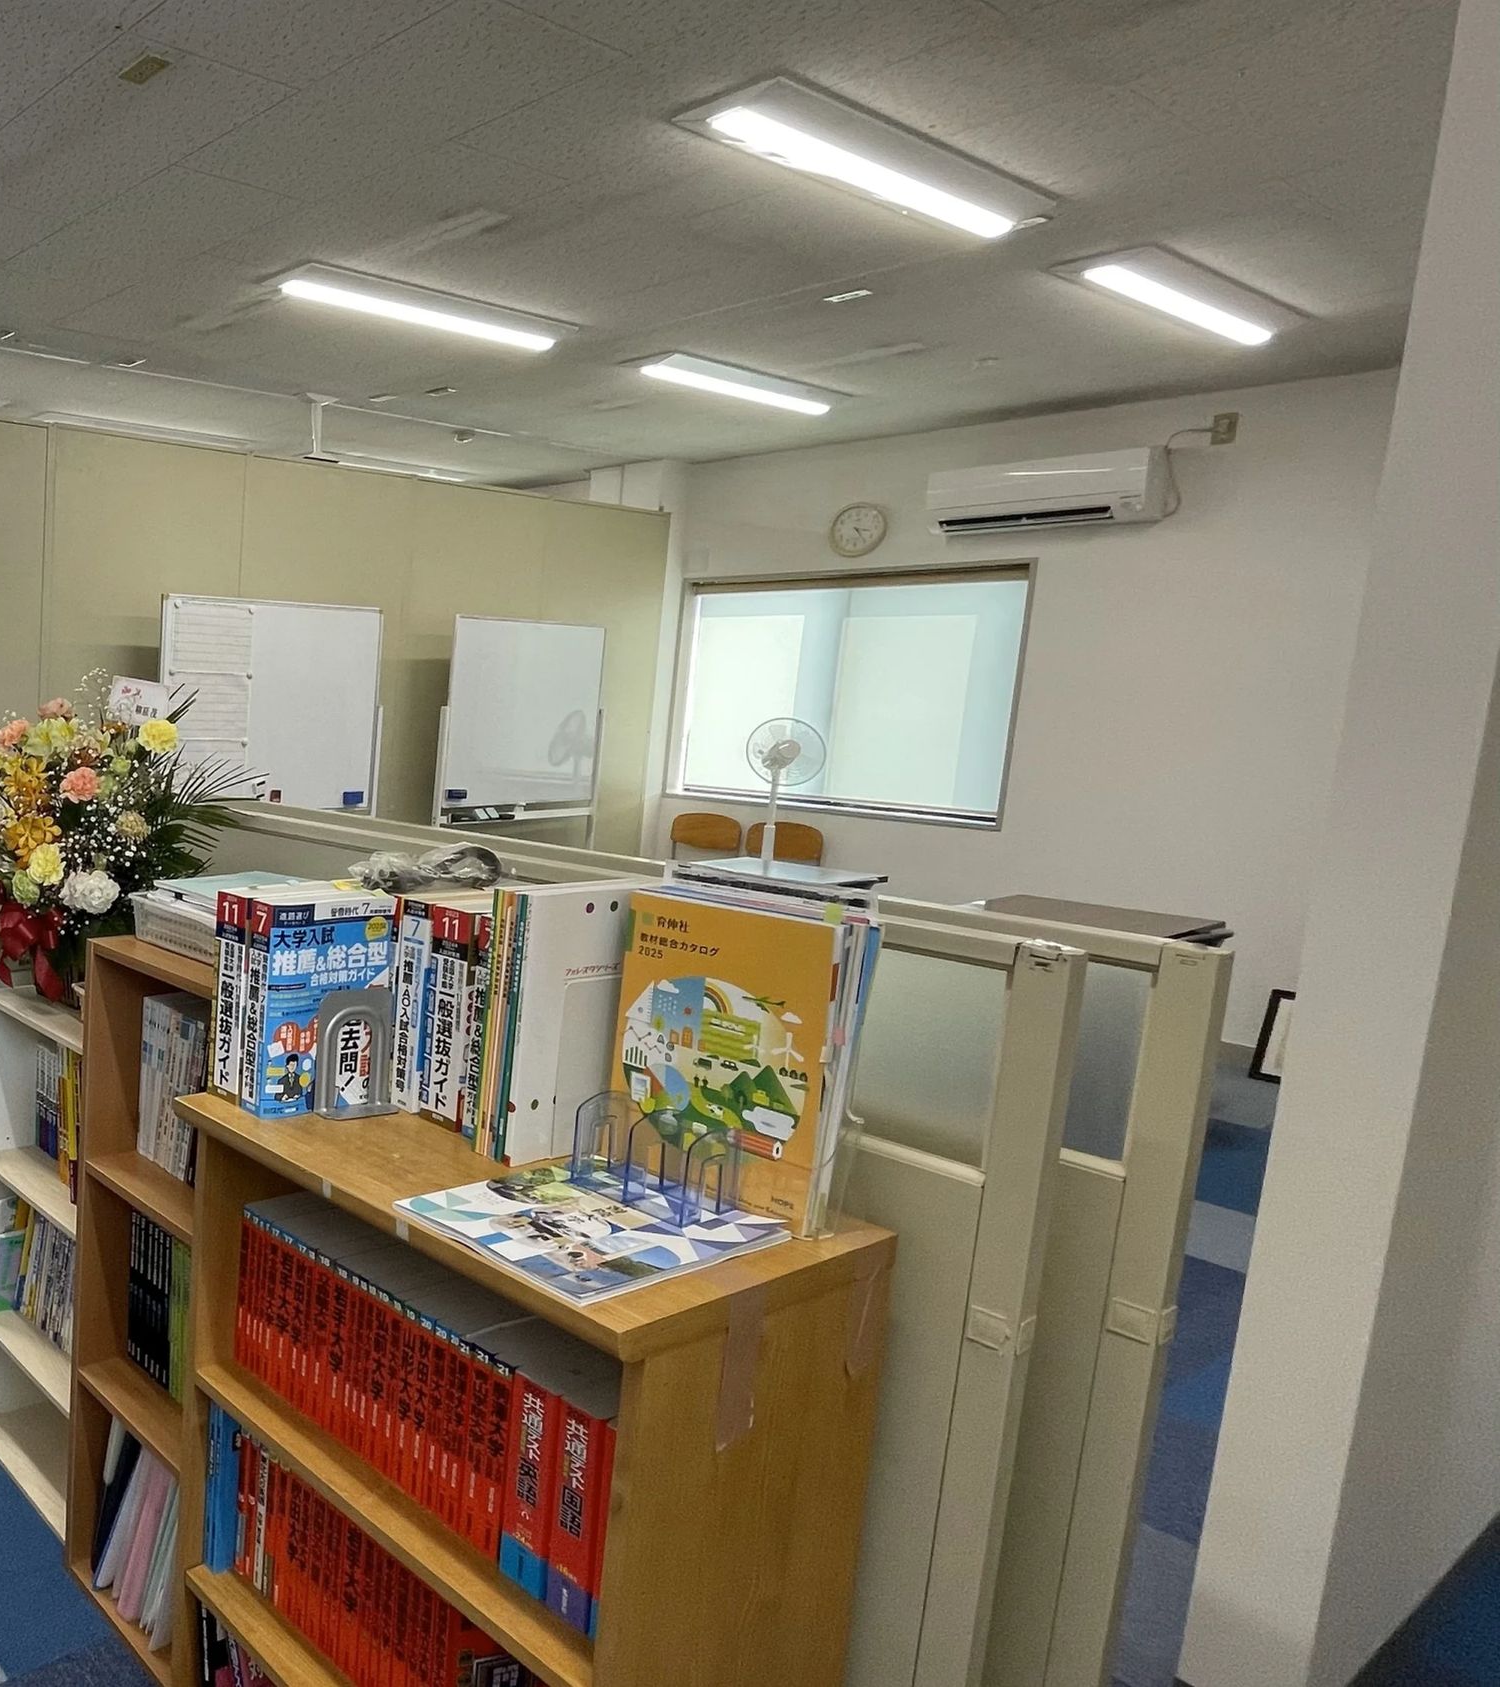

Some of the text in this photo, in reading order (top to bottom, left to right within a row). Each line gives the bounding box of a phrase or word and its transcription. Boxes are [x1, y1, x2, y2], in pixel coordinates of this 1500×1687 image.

[222, 901, 239, 925] 11
[256, 911, 268, 933] 7
[656, 915, 690, 934] 育伸社
[272, 925, 336, 949] 大学入試
[411, 918, 420, 937] 7
[442, 916, 460, 941] 11
[637, 945, 664, 960] 2025
[639, 932, 721, 957] 教材総合カタログ
[271, 940, 389, 977] 推薦&総合型
[309, 967, 376, 988] 合格対策ガイド
[217, 972, 236, 1086] 一般選抜ガイド
[433, 990, 456, 1110] 一般選抜ガイド
[521, 1392, 545, 1462] 共通テスト
[564, 1418, 589, 1491] 共通テスト
[515, 1456, 541, 1509] 英語
[559, 1484, 584, 1540] 国語
